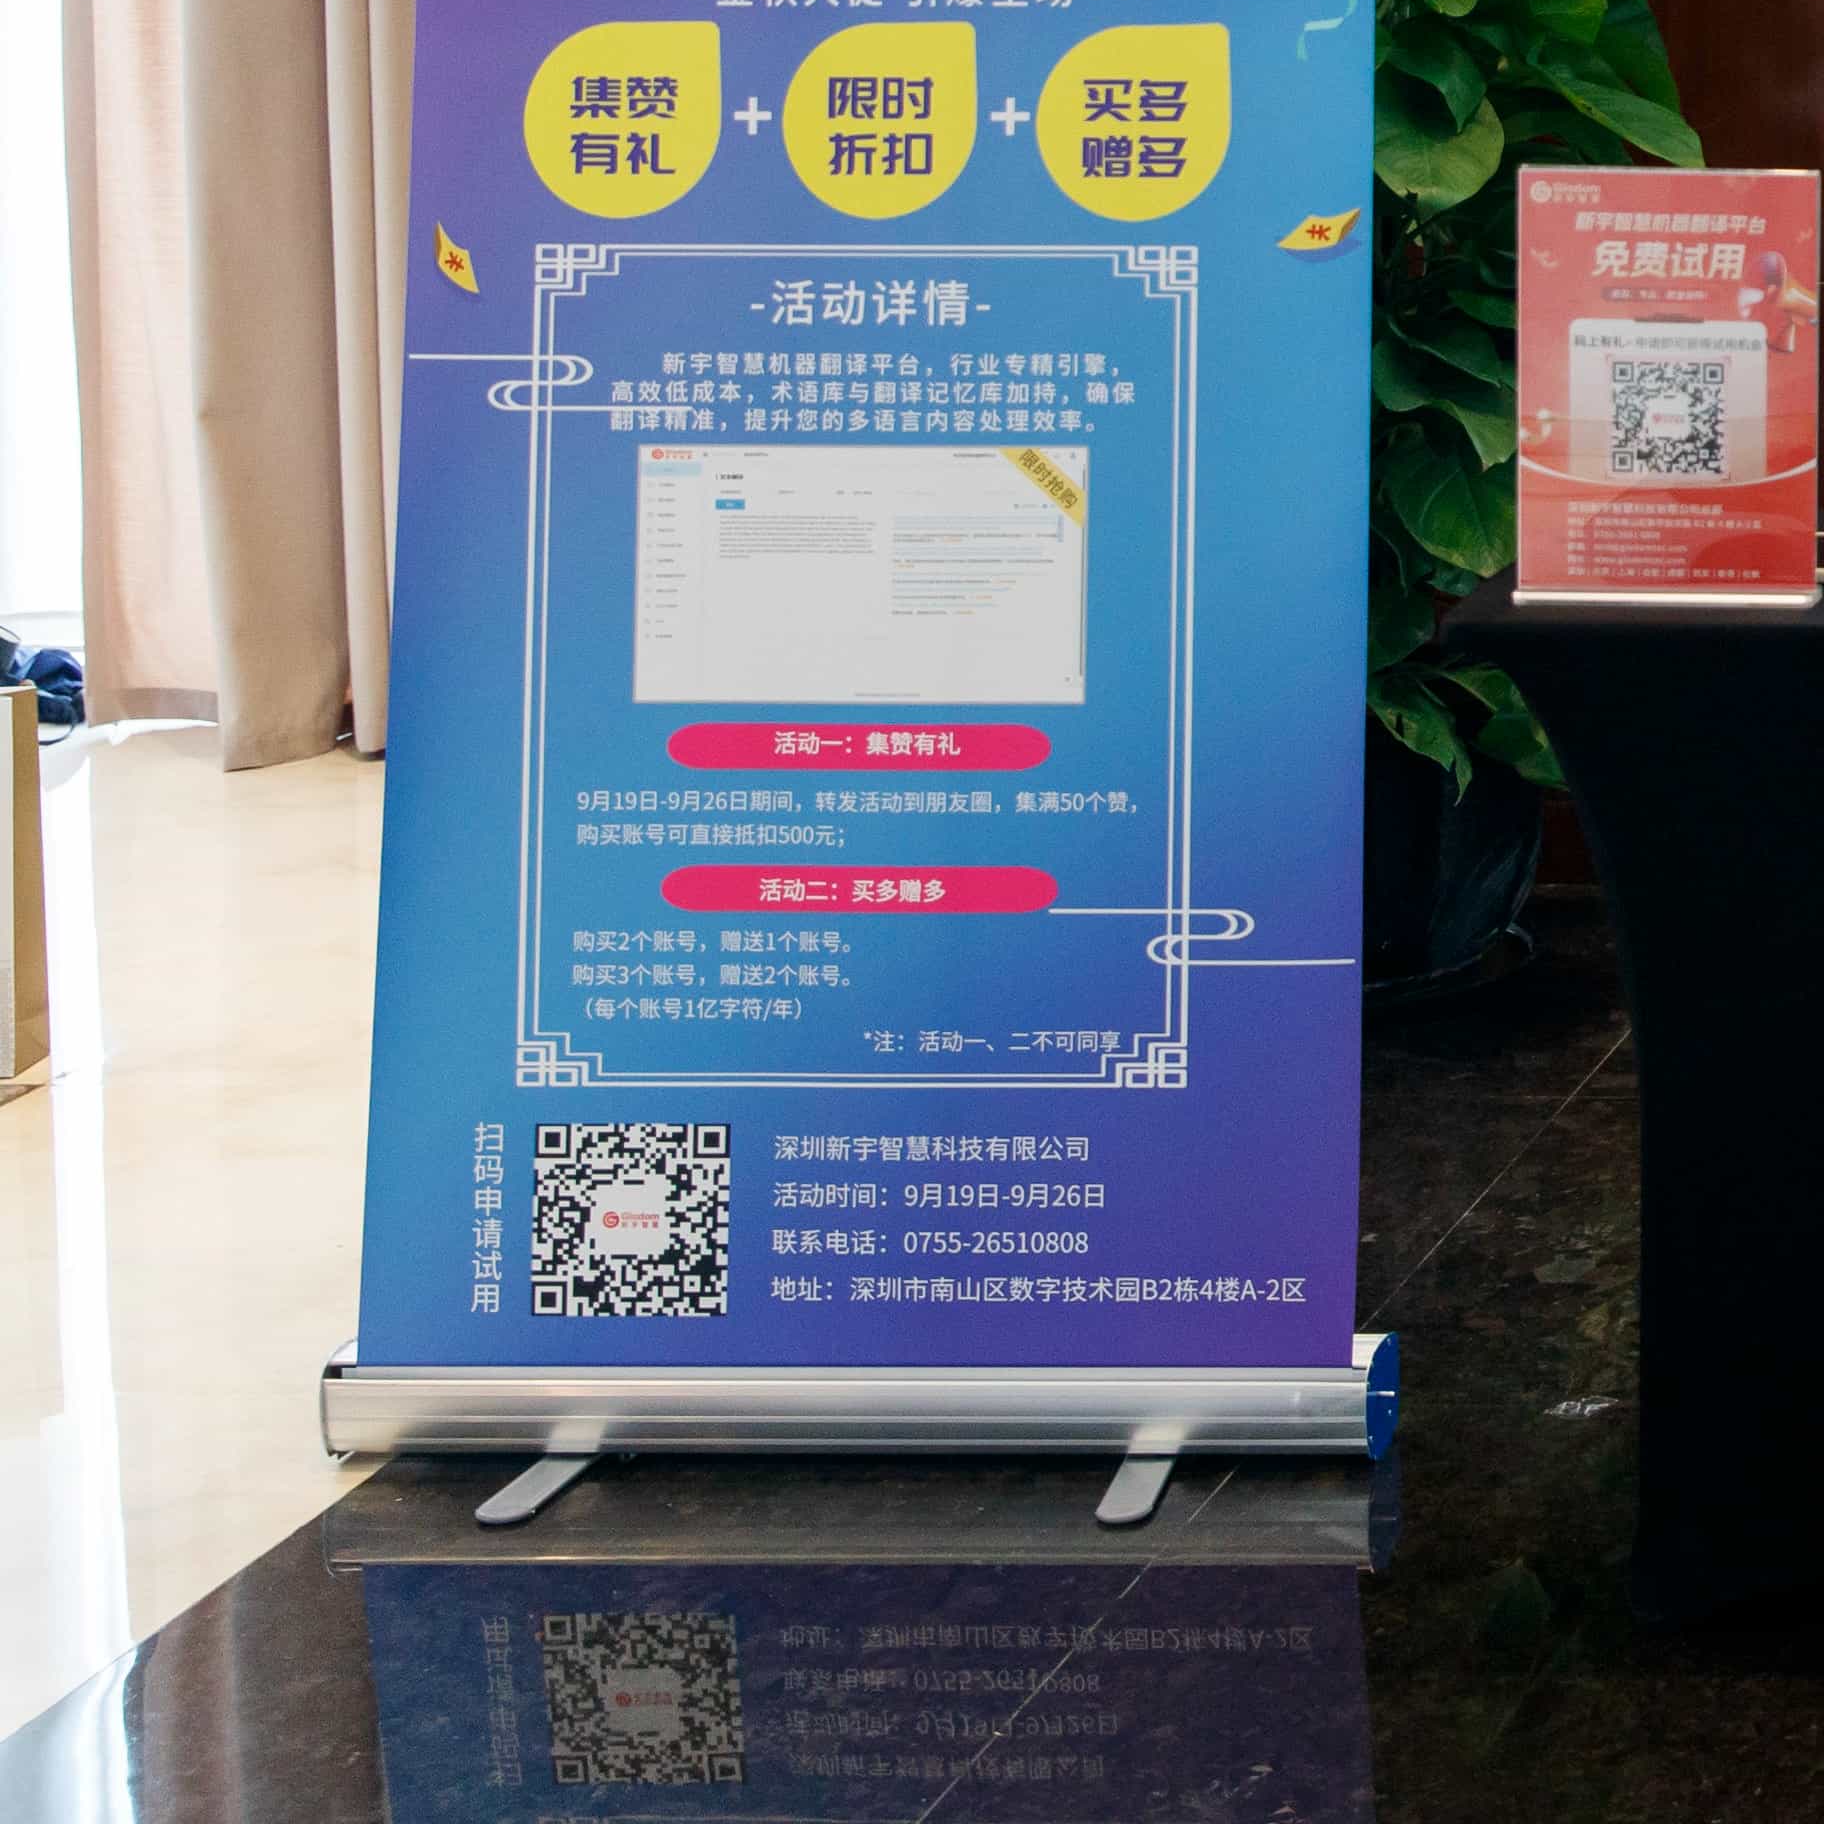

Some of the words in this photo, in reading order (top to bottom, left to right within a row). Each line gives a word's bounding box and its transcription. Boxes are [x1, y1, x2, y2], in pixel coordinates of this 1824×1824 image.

[570, 76, 679, 119] 集赞
[828, 77, 933, 120] 限时
[1084, 79, 1188, 122] 买多
[570, 133, 677, 176] 有礼
[829, 133, 933, 176] 折扣
[1082, 135, 1188, 179] 赠多
[1592, 239, 1746, 281] 免费试用
[774, 731, 961, 756] 活动一：集赞有礼
[759, 878, 946, 904] 活动二：买多赠多
[774, 1135, 1090, 1163] 深圳新宇智慧科技有限公司
[773, 1181, 1107, 1210] 活动时间：9月19日-9月26日
[471, 1122, 505, 1314] 扫码申请试用
[772, 1228, 1090, 1257] 联系电话：0755-26510808
